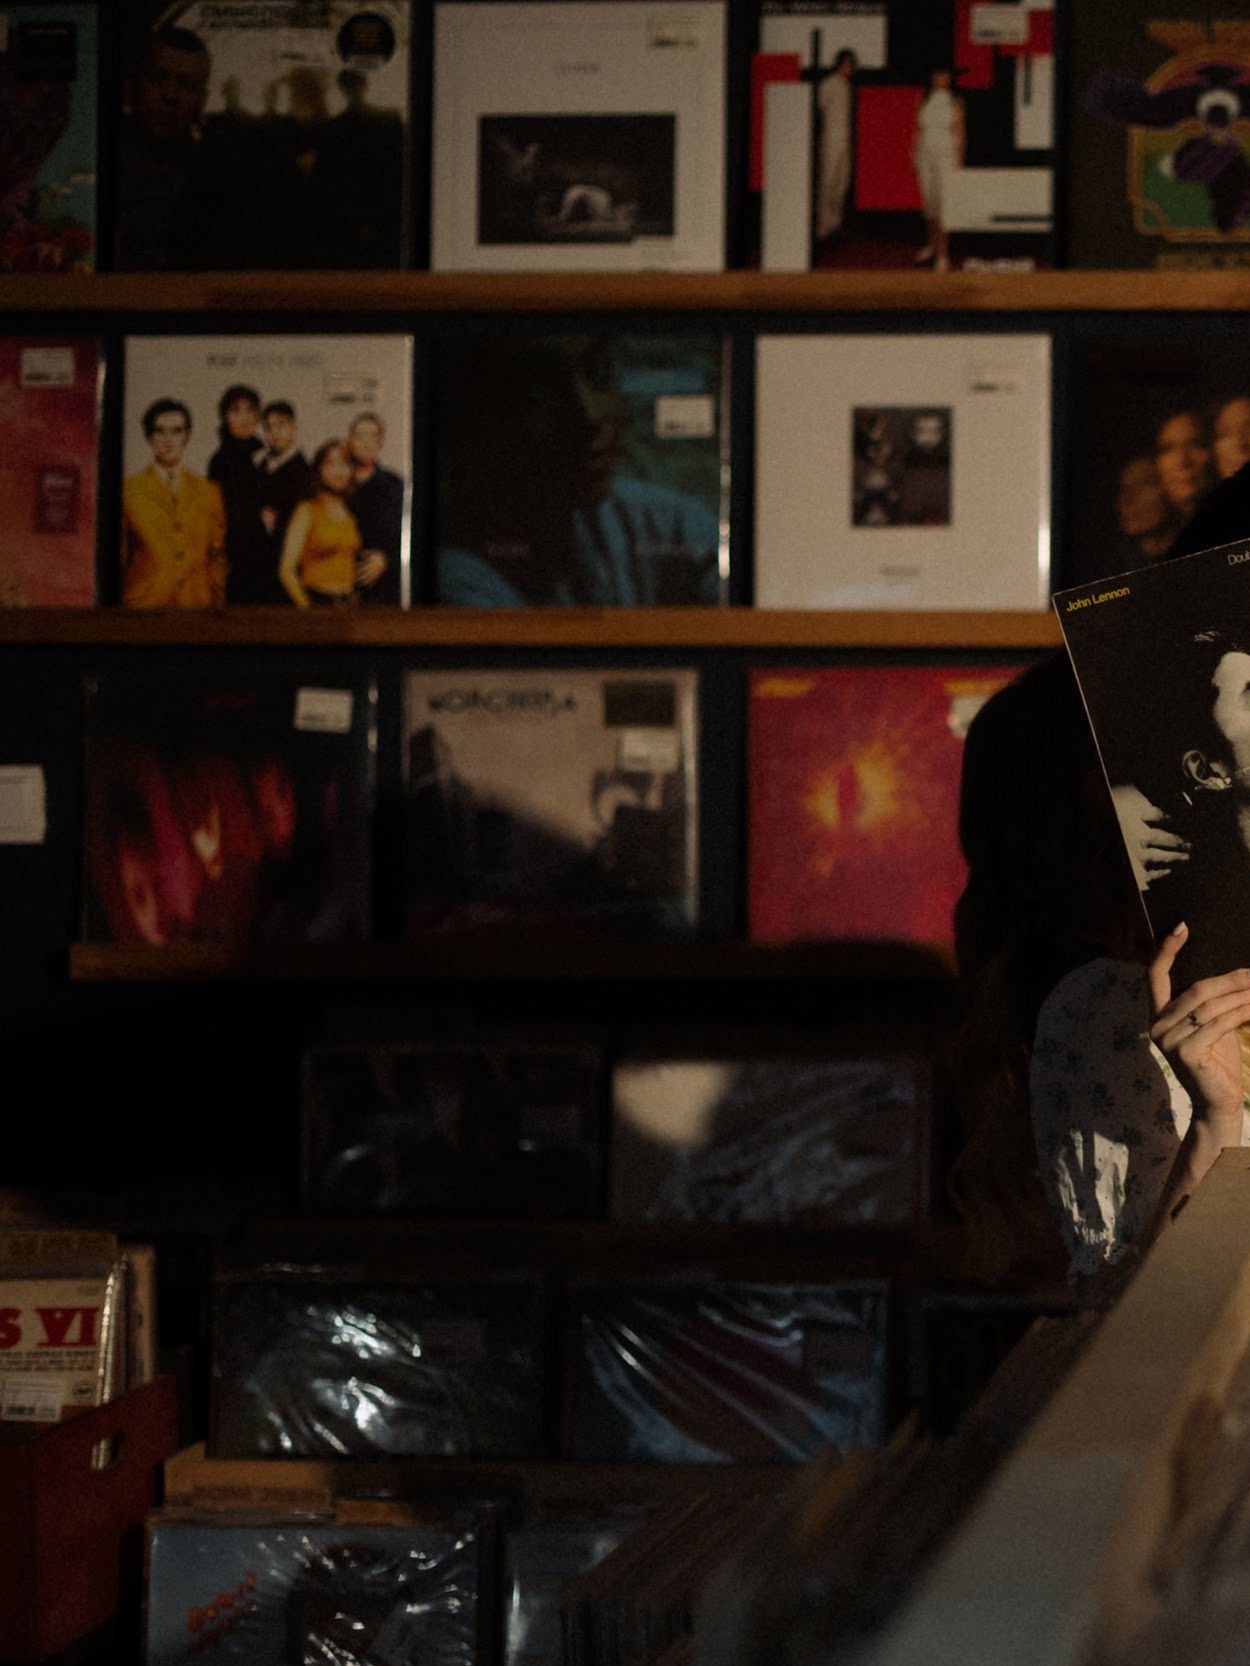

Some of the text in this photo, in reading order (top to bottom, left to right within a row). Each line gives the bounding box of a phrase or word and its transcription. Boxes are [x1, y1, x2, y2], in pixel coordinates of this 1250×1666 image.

[1066, 586, 1131, 612] John Lennon
[35, 1306, 99, 1348] VI
